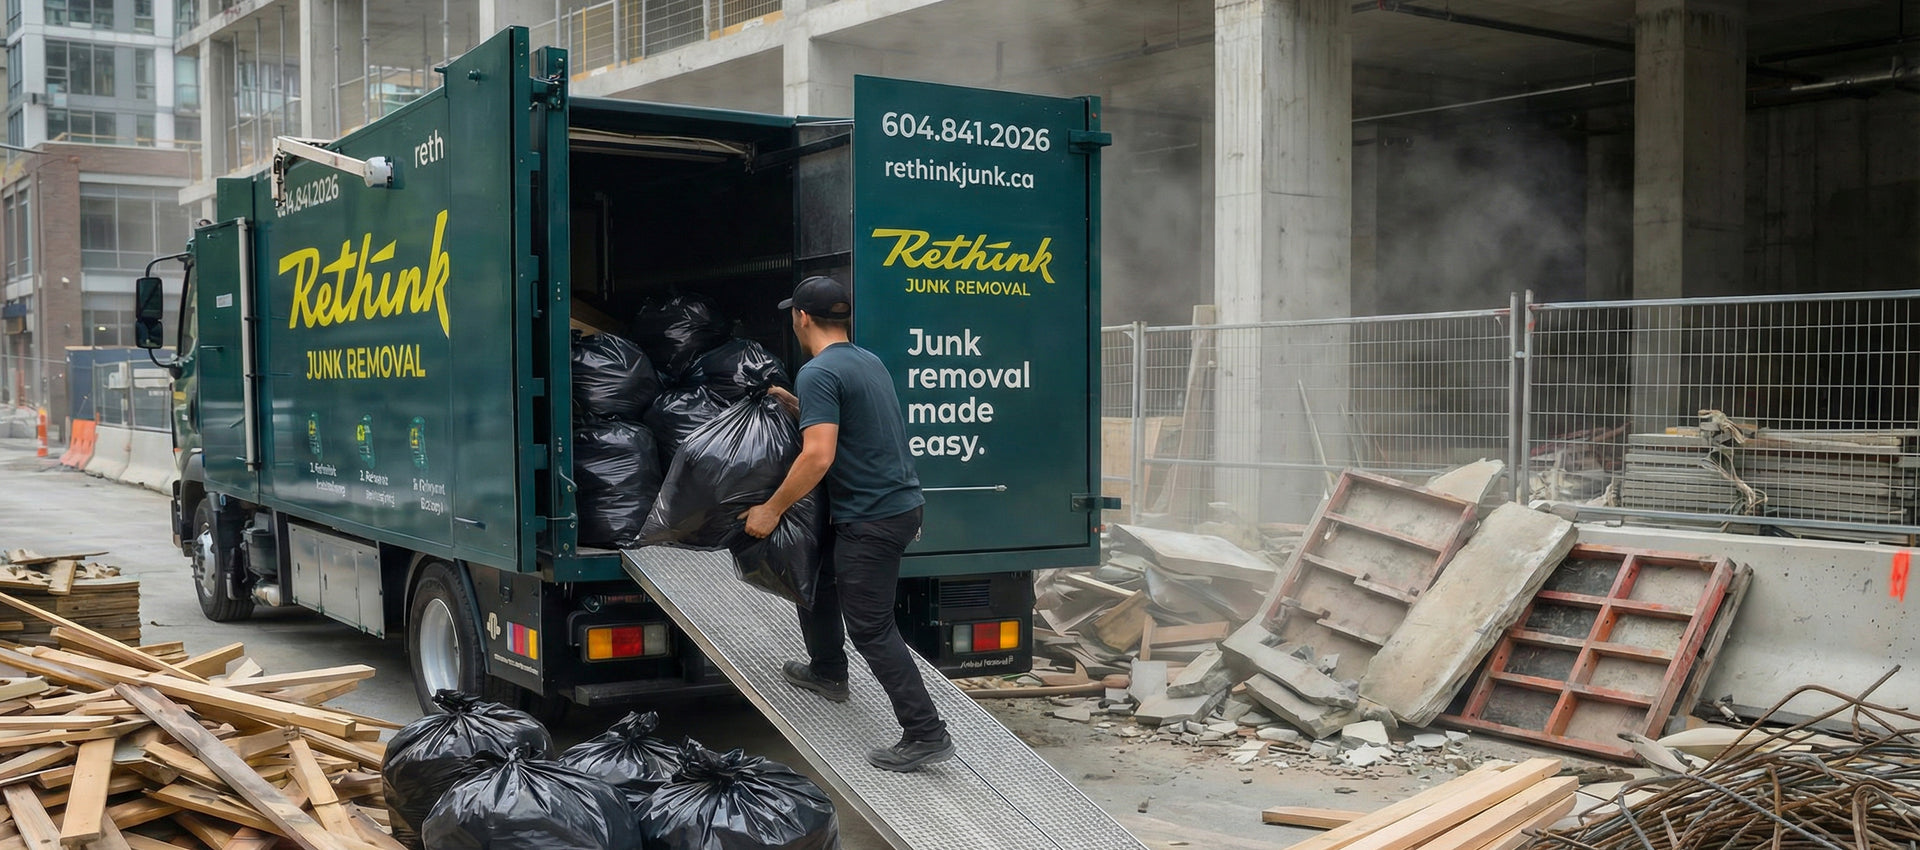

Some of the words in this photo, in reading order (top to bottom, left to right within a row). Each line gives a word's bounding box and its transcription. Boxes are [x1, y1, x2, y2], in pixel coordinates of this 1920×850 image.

[882, 111, 1051, 152] 604.841.2026
[414, 129, 445, 169] reth
[885, 158, 1035, 189] rethinkjunk.ca
[276, 173, 339, 219] 4.841.2026
[871, 228, 1056, 284] Rethink
[278, 209, 450, 340] Rethink
[905, 278, 950, 294] JUNK
[955, 280, 1031, 297] REMOVAL
[907, 328, 982, 356] Junk
[306, 348, 344, 381] JUNK
[347, 343, 427, 380] REMOVAL
[908, 360, 1030, 389] removal
[908, 396, 994, 424] made
[908, 435, 985, 462] easy.
